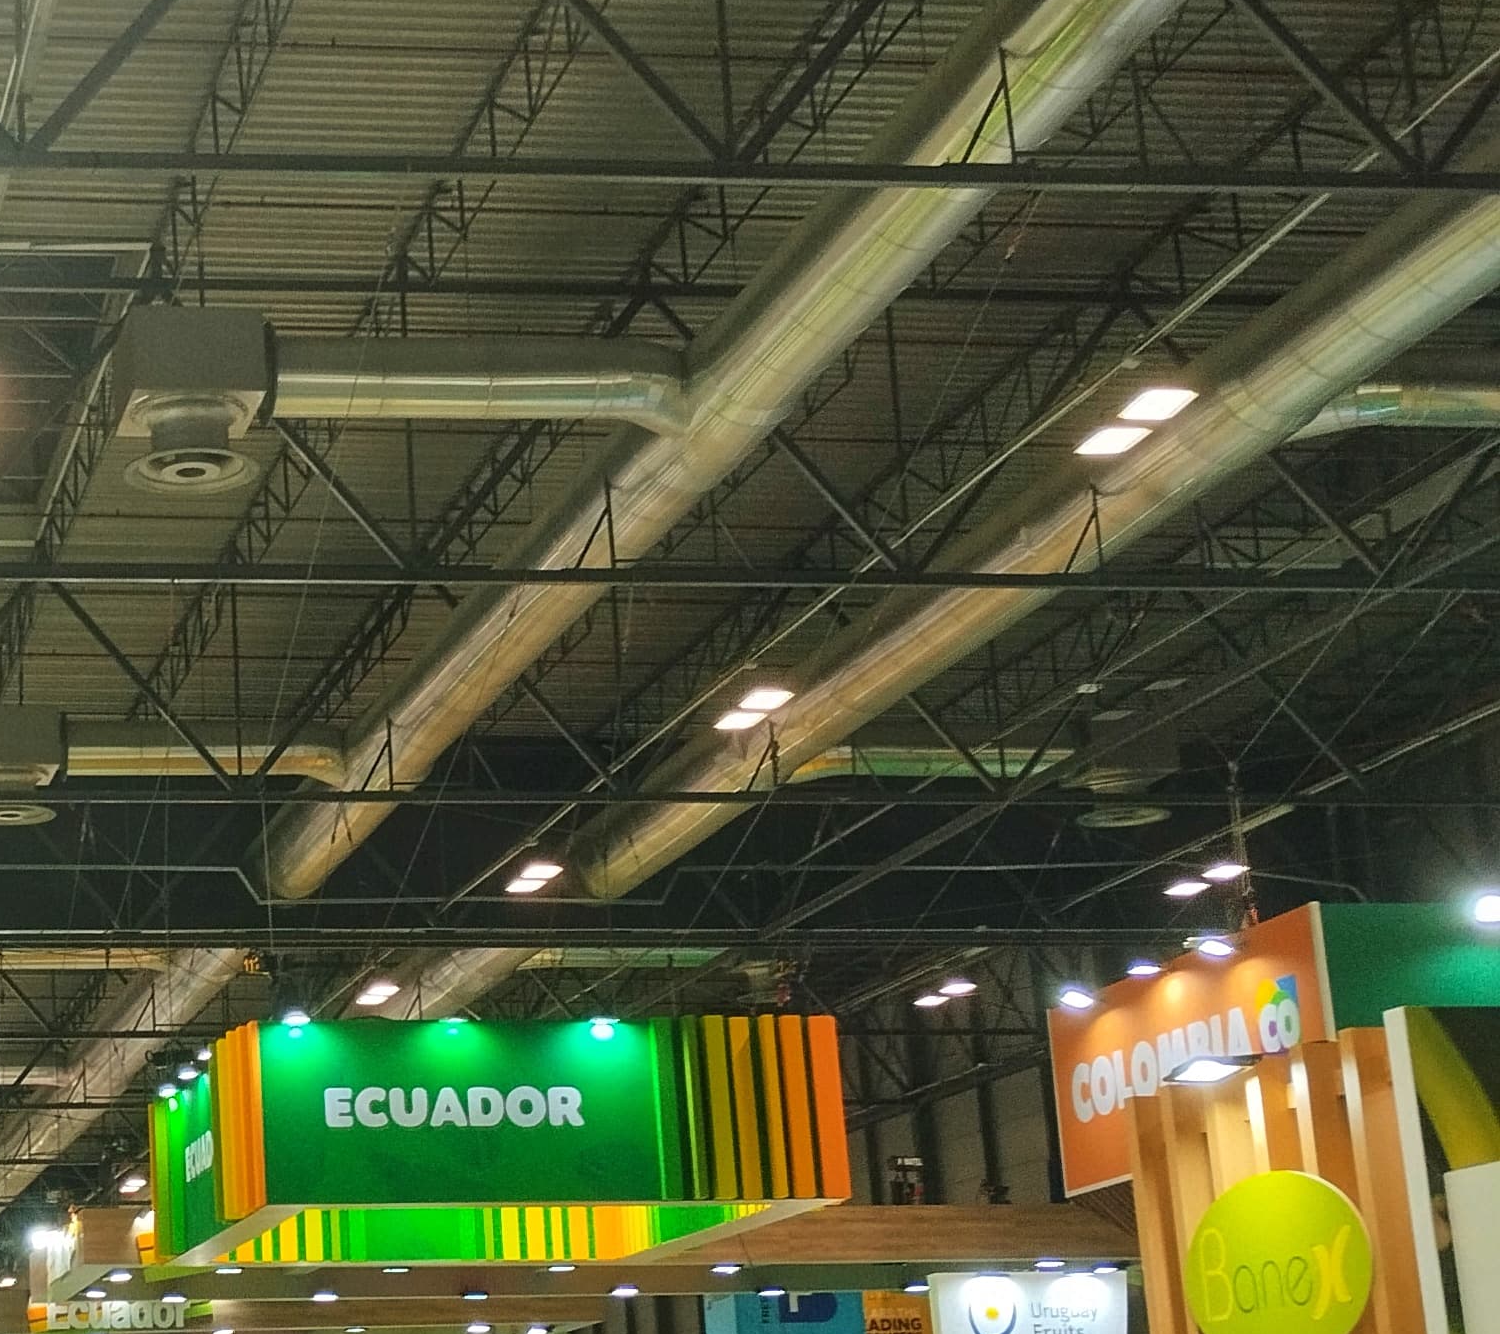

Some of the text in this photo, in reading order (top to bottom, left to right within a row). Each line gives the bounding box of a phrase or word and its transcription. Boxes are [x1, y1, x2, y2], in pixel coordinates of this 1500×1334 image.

[1072, 1007, 1252, 1124] COLOMBIA
[323, 1085, 585, 1128] ECUADOR
[47, 1300, 187, 1330] Ecuador
[867, 1318, 922, 1332] ADING
